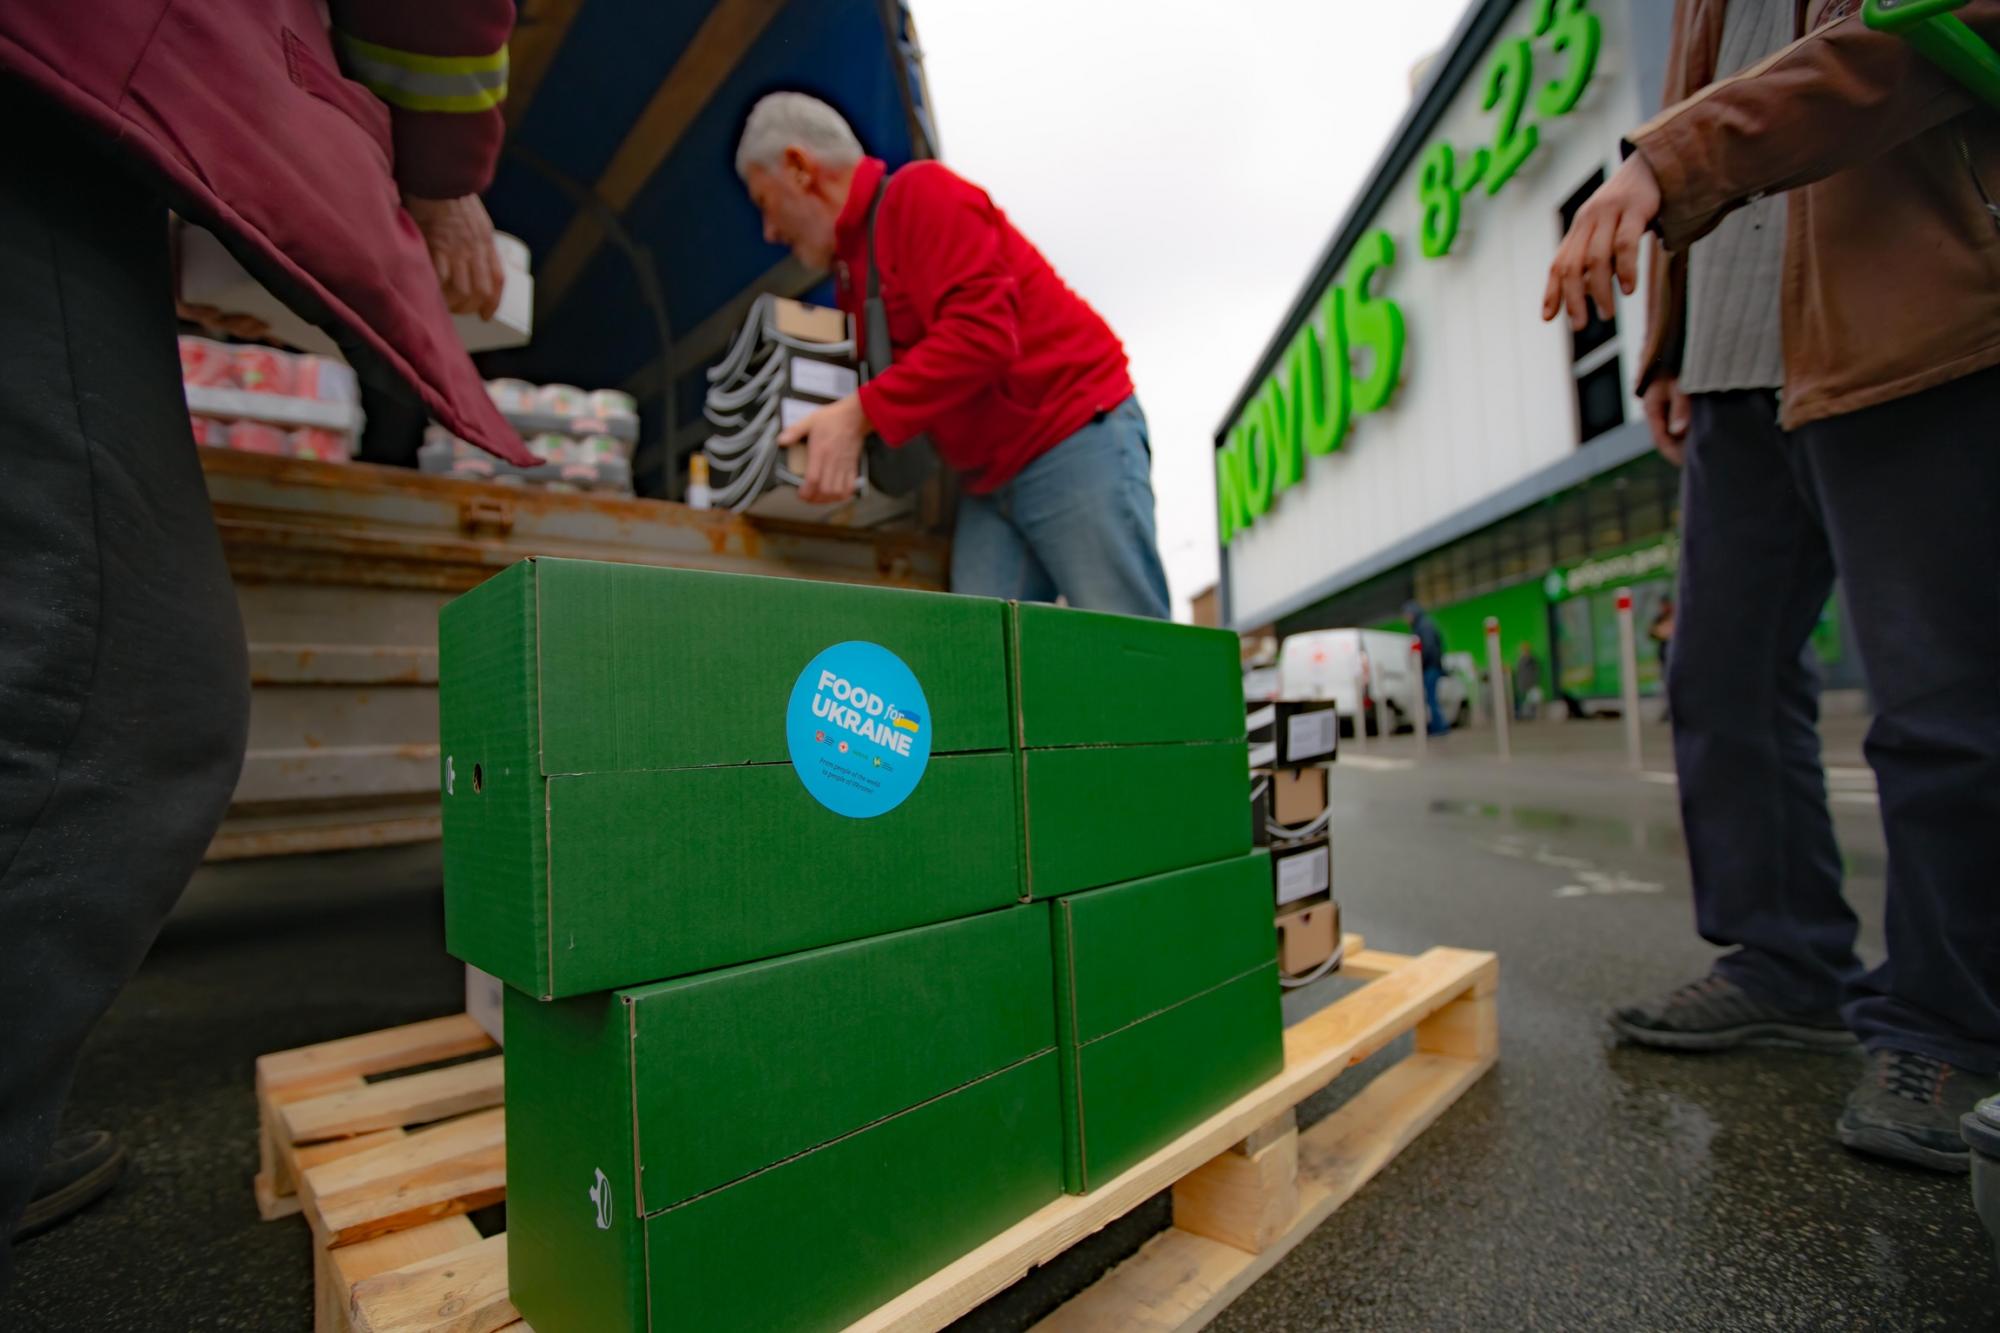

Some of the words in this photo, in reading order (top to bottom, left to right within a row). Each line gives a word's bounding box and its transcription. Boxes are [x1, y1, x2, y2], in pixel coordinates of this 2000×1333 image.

[1217, 229, 1406, 543] NOVUS
[1419, 0, 1602, 259] 8-23
[812, 693, 913, 757] UKRAINE
[818, 670, 884, 716] FOOD
[884, 703, 905, 724] for
